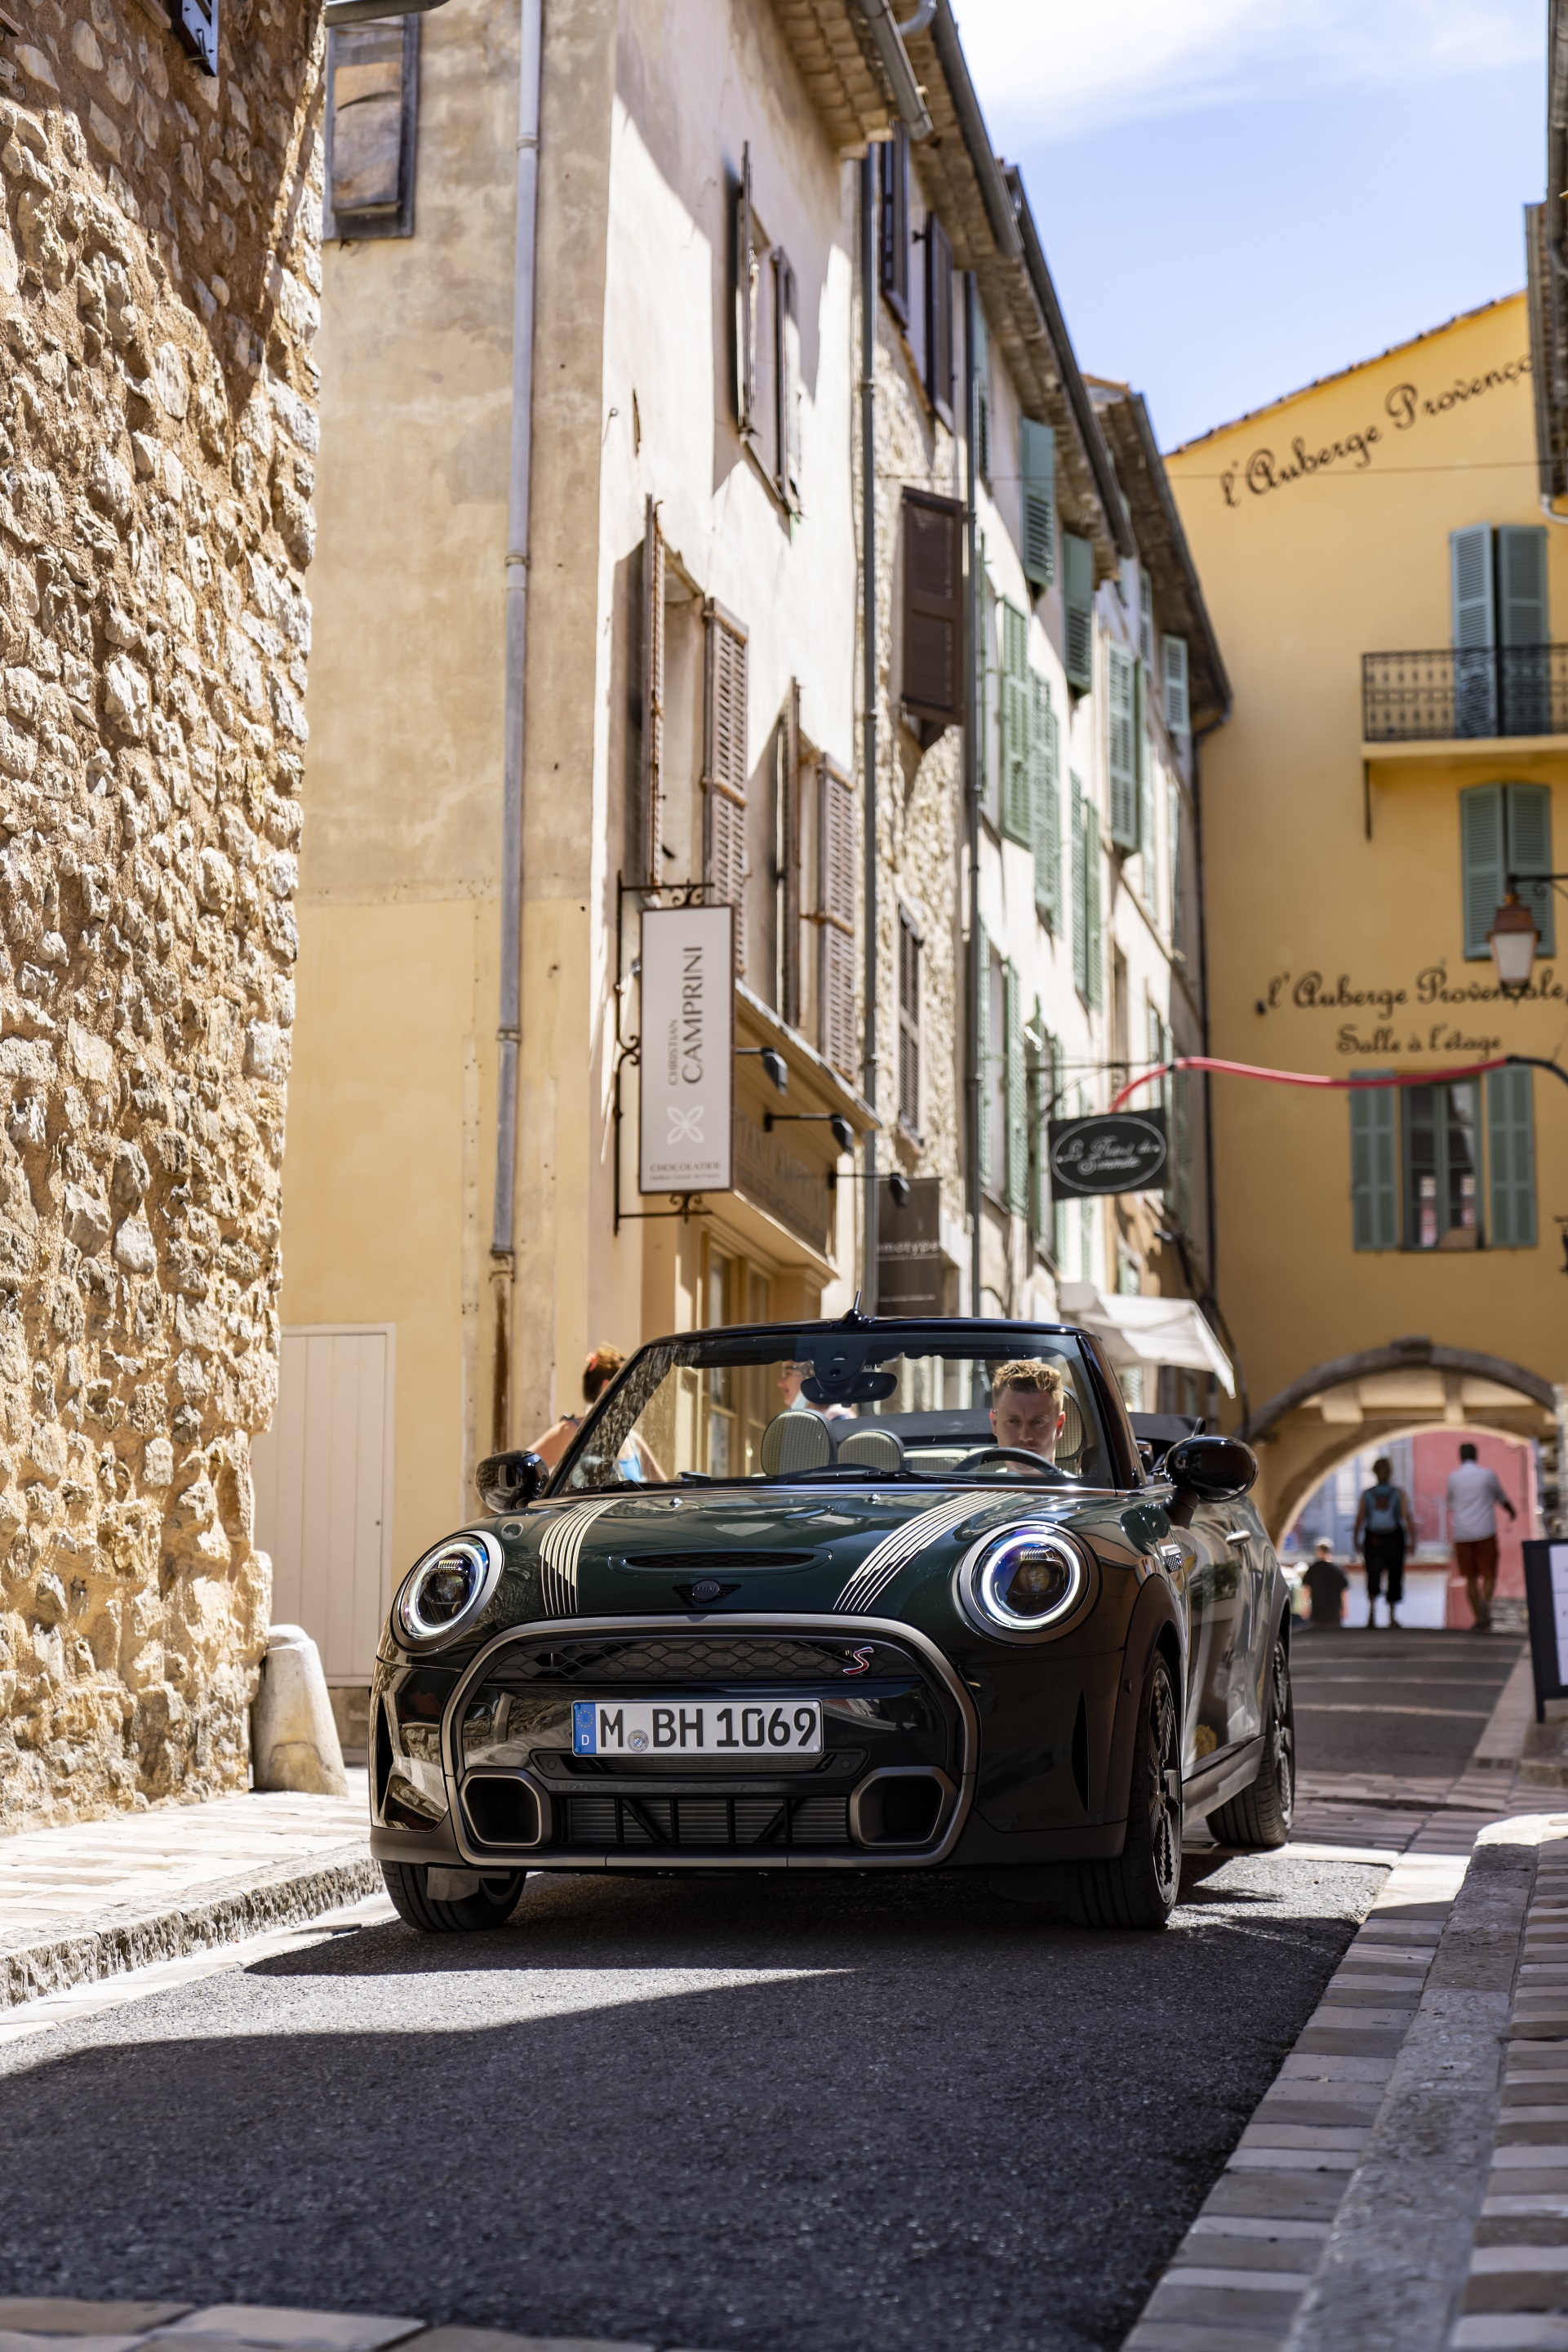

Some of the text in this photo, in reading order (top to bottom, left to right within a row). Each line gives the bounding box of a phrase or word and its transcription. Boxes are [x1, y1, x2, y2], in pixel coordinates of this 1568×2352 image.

[1220, 425, 1384, 508] l'Auberge
[682, 946, 703, 1084] CAMPRINI
[1268, 971, 1409, 1020] l'Auberge
[1336, 1024, 1401, 1055] Salle
[582, 1734, 590, 1746] D
[600, 1709, 624, 1747] M
[653, 1709, 704, 1747] BH
[716, 1708, 816, 1747] 1069
